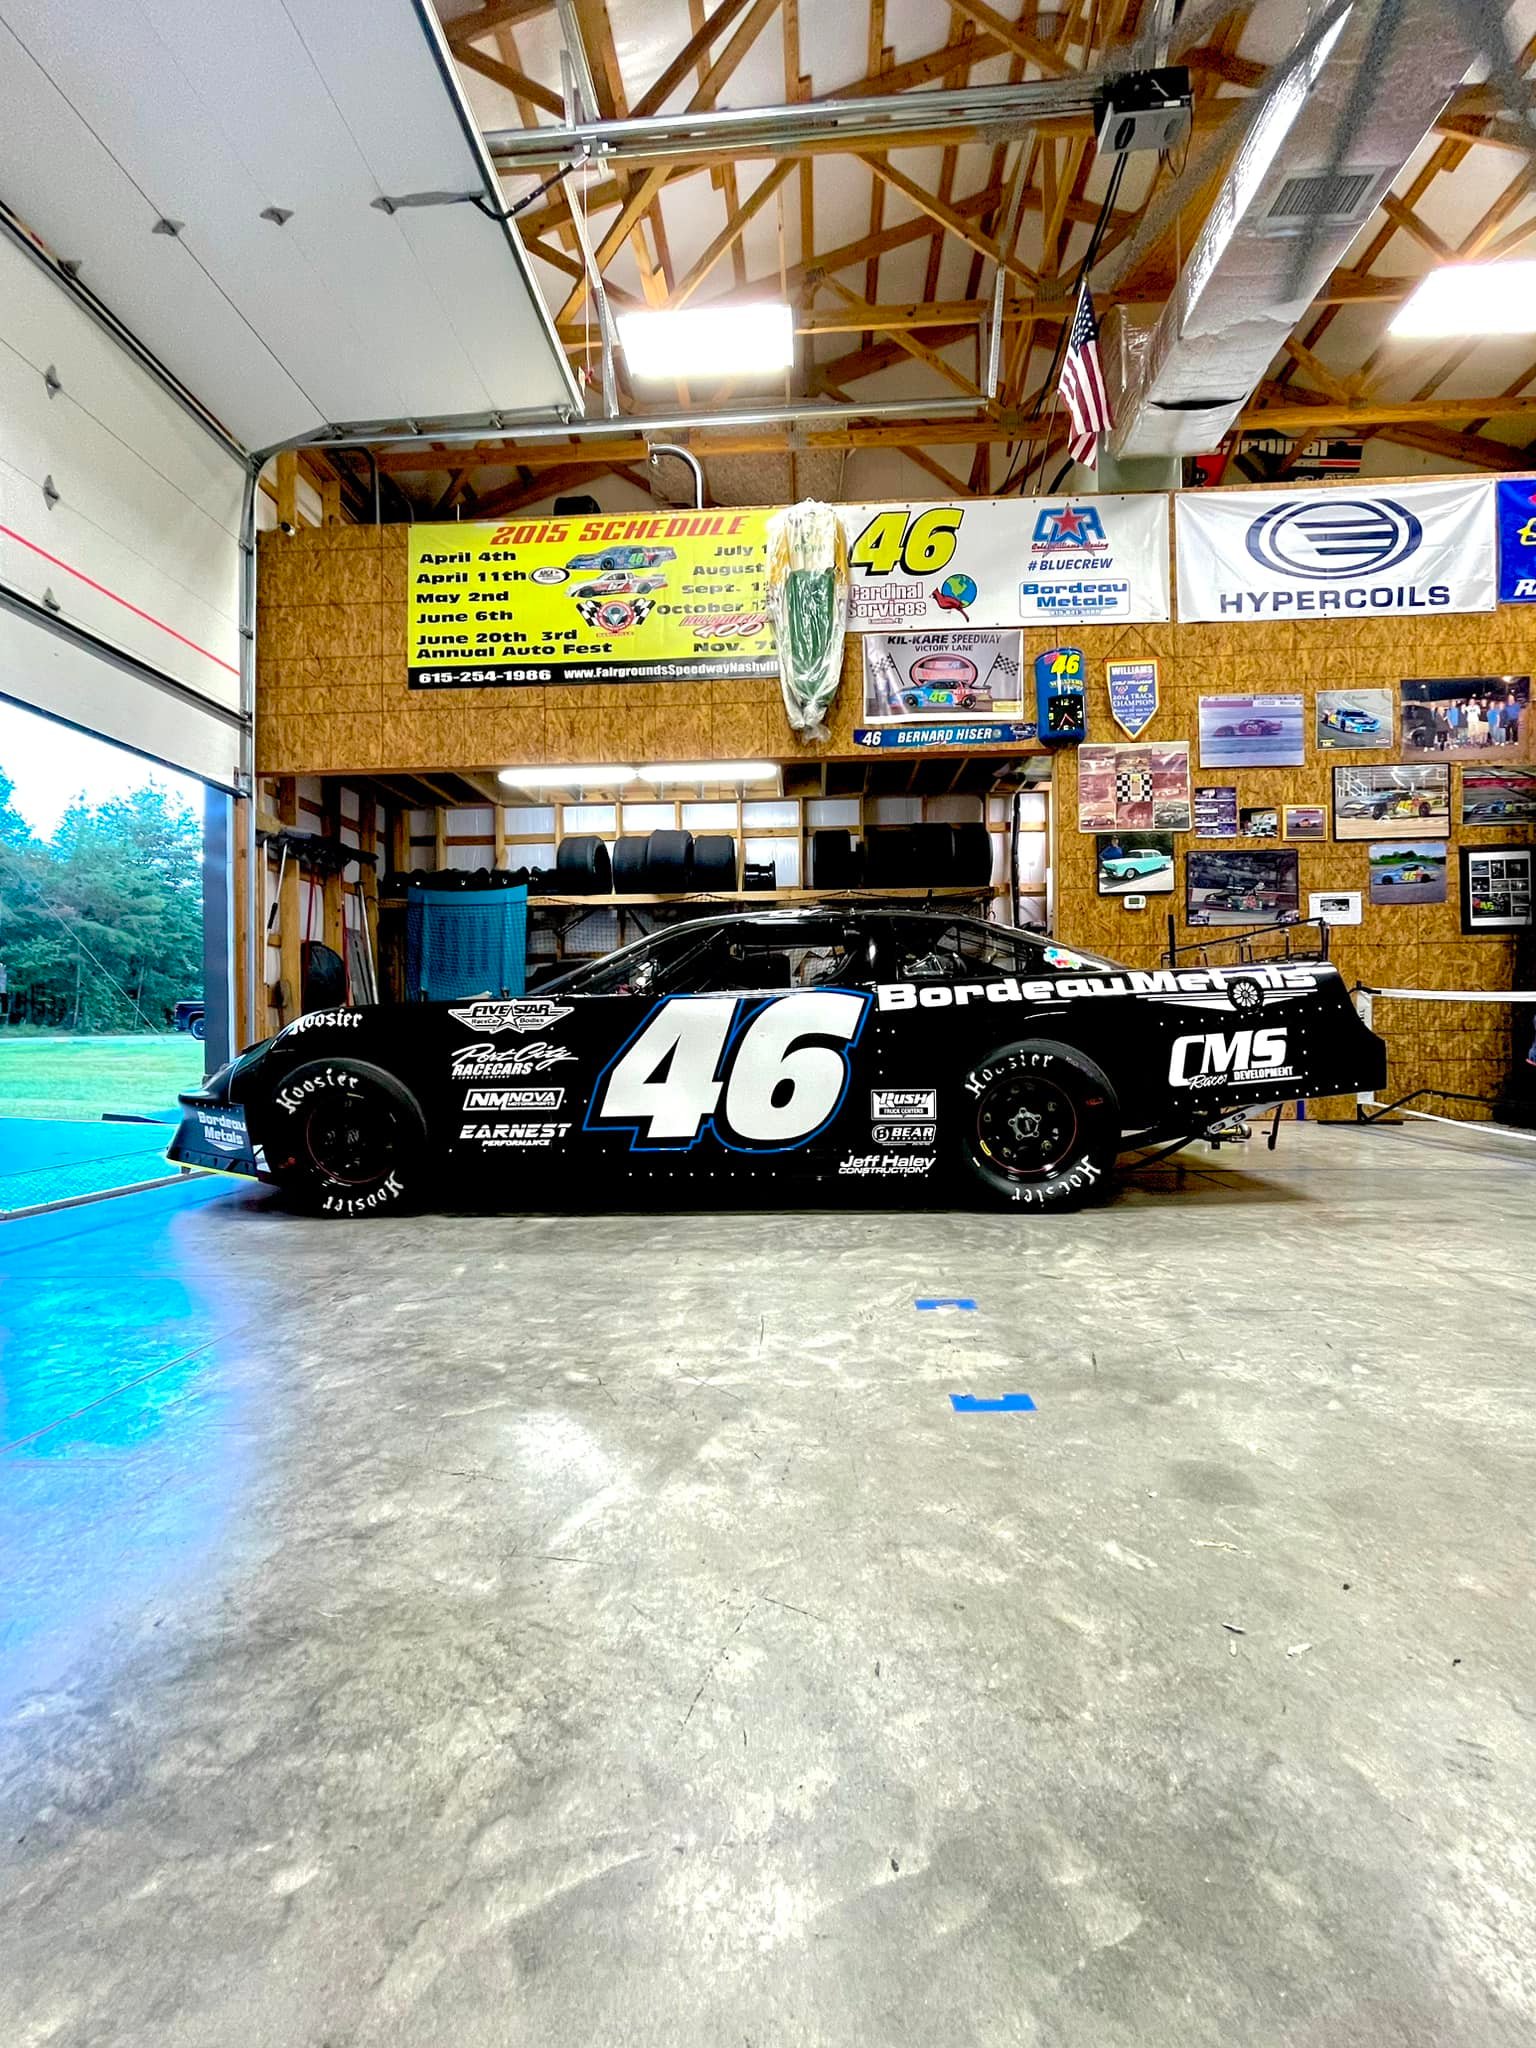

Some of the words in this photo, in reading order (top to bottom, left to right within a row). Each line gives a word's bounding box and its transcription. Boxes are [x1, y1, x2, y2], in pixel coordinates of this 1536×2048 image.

[490, 523, 571, 545] 2015
[578, 516, 750, 542] SCHEDULE
[849, 507, 965, 576] 46
[419, 552, 471, 565] April
[478, 551, 516, 563] 4th
[714, 545, 754, 557] July
[692, 563, 765, 576] August
[416, 572, 469, 585] April
[477, 570, 527, 582] 11th
[681, 583, 741, 595] Sept.
[850, 580, 923, 601] Cardinal
[1022, 582, 1128, 595] Bordeau
[416, 593, 461, 604] May
[468, 591, 510, 602] 2nd
[1036, 594, 1119, 608] Metals
[1219, 585, 1450, 614] HYPERCOILS
[656, 600, 744, 615] October
[848, 600, 927, 619] Services
[416, 613, 469, 624] June
[475, 610, 513, 622] 6th
[416, 634, 469, 645] June
[476, 632, 527, 643] 20th
[541, 630, 578, 641] 3rd
[887, 634, 949, 645] KIL-KARE
[951, 633, 1003, 644] SPEEDWAY
[416, 646, 495, 659] Annual
[502, 646, 556, 657] Auto
[563, 643, 613, 655] Fest
[693, 642, 745, 653] Nov.
[915, 644, 949, 652] VICTORY
[951, 644, 974, 652] LANE
[1051, 654, 1080, 674] 46
[1111, 665, 1153, 675] WILLIAMS
[418, 669, 552, 684] 615-254-1986
[928, 690, 947, 703] 46
[1112, 699, 1155, 707] CHAMPION
[861, 731, 882, 746] 46
[897, 729, 953, 743] BERNARD
[956, 728, 993, 740] HISER
[877, 977, 1128, 1012] Bordeau
[471, 1005, 509, 1017] FIVE
[513, 1004, 551, 1016] STAR
[451, 1043, 517, 1067] Port
[513, 1042, 579, 1071] City
[1168, 1027, 1288, 1087] CMS
[451, 1061, 534, 1076] RACECARS
[598, 990, 867, 1142] 46
[1233, 1065, 1294, 1081] DEVELOPMENT
[276, 1067, 360, 1115] Hoosier
[879, 1092, 928, 1108] RUSH
[197, 1111, 247, 1132] Bordeau
[204, 1125, 244, 1145] Metals
[459, 1123, 572, 1139] EARNEST
[891, 1127, 934, 1137] BEAR
[481, 1139, 551, 1147] PERFORMANCE
[840, 1155, 880, 1168] Jeff
[881, 1155, 936, 1170] Haley
[838, 1167, 924, 1175] CONSTRUCTION
[323, 1170, 404, 1217] Hoosier
